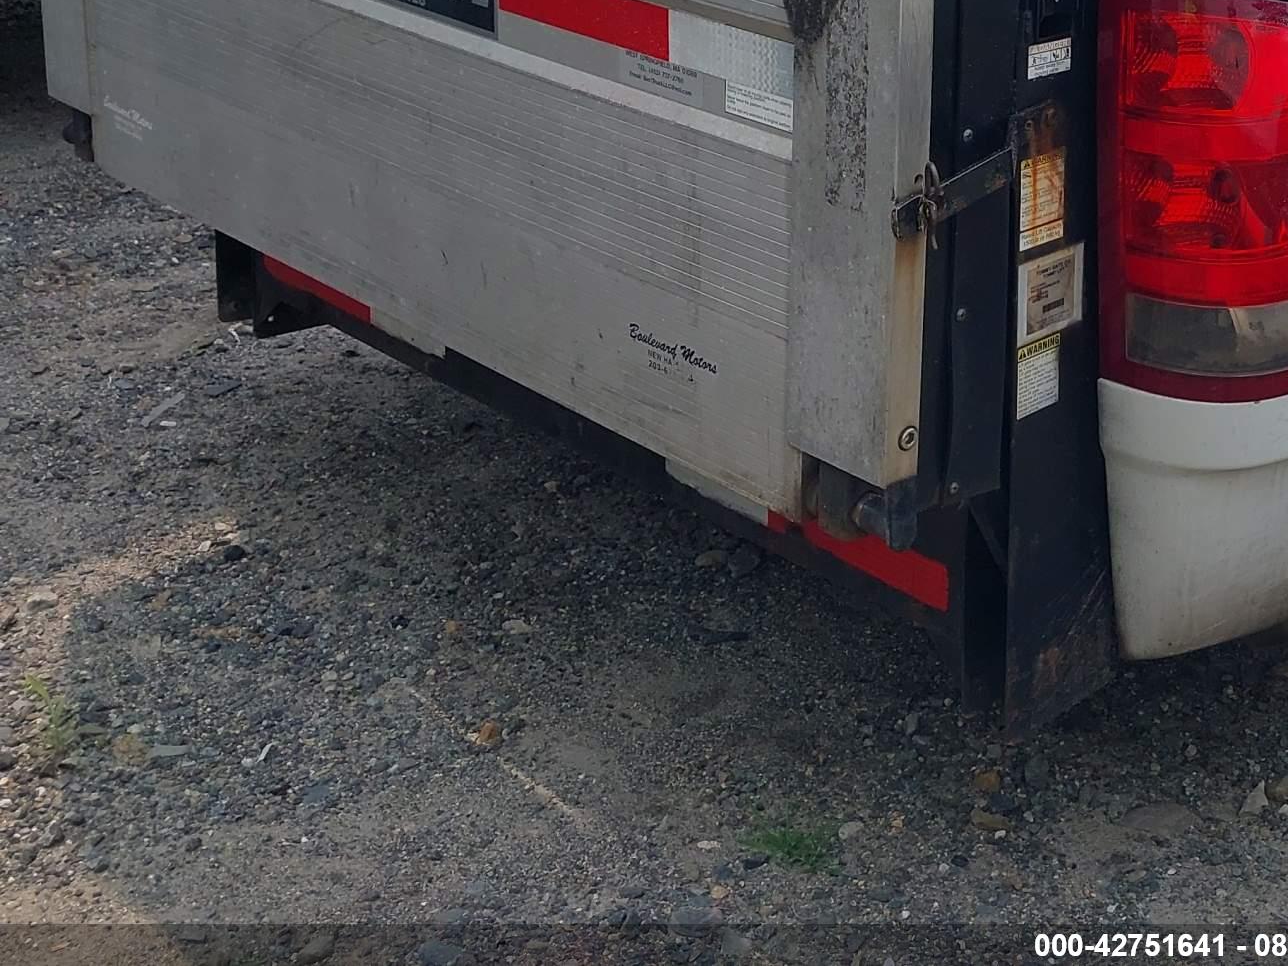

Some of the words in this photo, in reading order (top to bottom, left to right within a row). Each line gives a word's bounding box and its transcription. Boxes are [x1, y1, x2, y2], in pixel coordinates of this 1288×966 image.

[629, 323, 679, 359] Boulevard
[680, 345, 718, 374] Motors
[1026, 335, 1060, 357] WARNING
